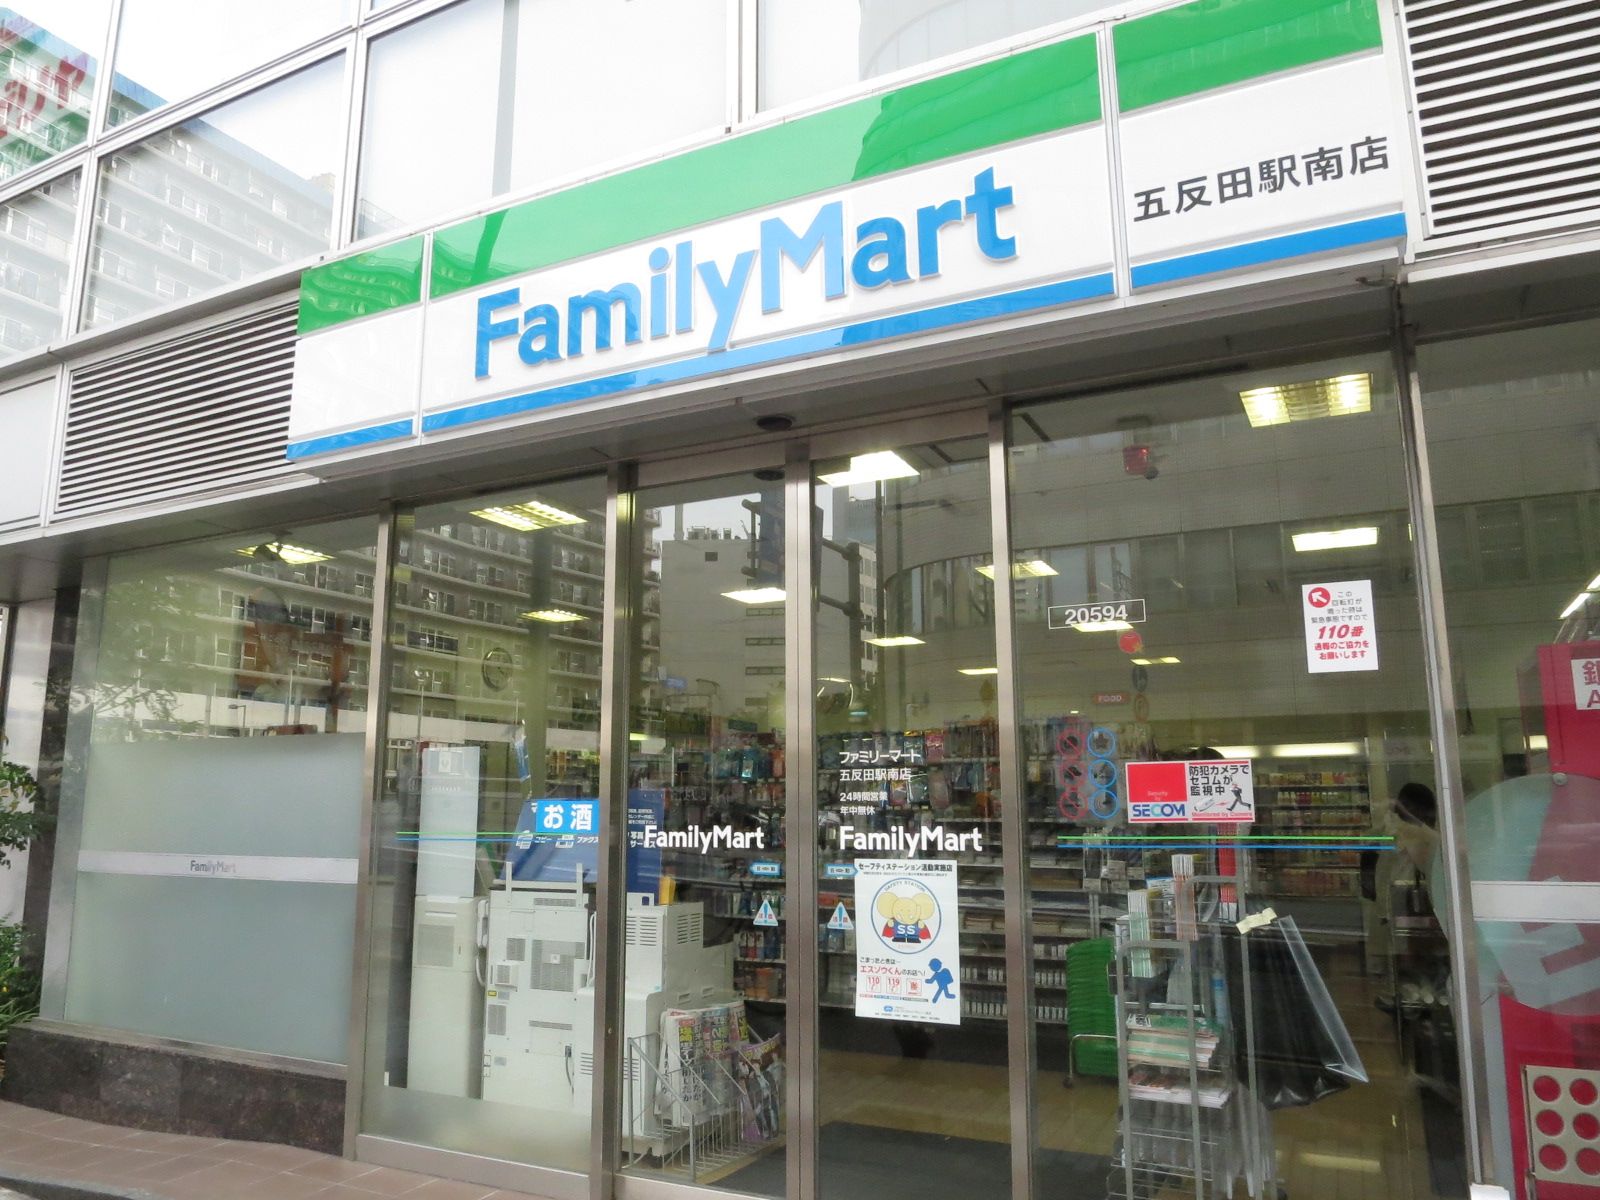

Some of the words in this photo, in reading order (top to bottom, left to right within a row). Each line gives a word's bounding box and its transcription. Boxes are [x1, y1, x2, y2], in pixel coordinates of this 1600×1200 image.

[1133, 136, 1390, 222] 五反田駅南店
[475, 166, 1019, 380] FamilyMart
[1064, 604, 1128, 625] 20594
[1318, 624, 1365, 639] 110番
[1314, 640, 1370, 651] 通報のご協力を
[1319, 650, 1367, 660] お願いします
[839, 749, 921, 764] ファミリーマート
[839, 767, 912, 782] 五反田駅南店
[1189, 765, 1250, 776] 防犯カメラで
[1190, 775, 1233, 785] セコムが
[1190, 785, 1226, 796] 監視中
[840, 791, 888, 802] 24時間営業
[840, 805, 876, 816] 年中無休
[1132, 804, 1186, 817] SECOM
[543, 803, 593, 831] お酒
[642, 824, 765, 855] FamilyMart
[839, 825, 983, 858] FamilyMart
[858, 862, 953, 872] セーフティステーション活動実施店
[897, 925, 916, 935] SS
[868, 976, 880, 985] 110
[888, 977, 900, 986] 119
